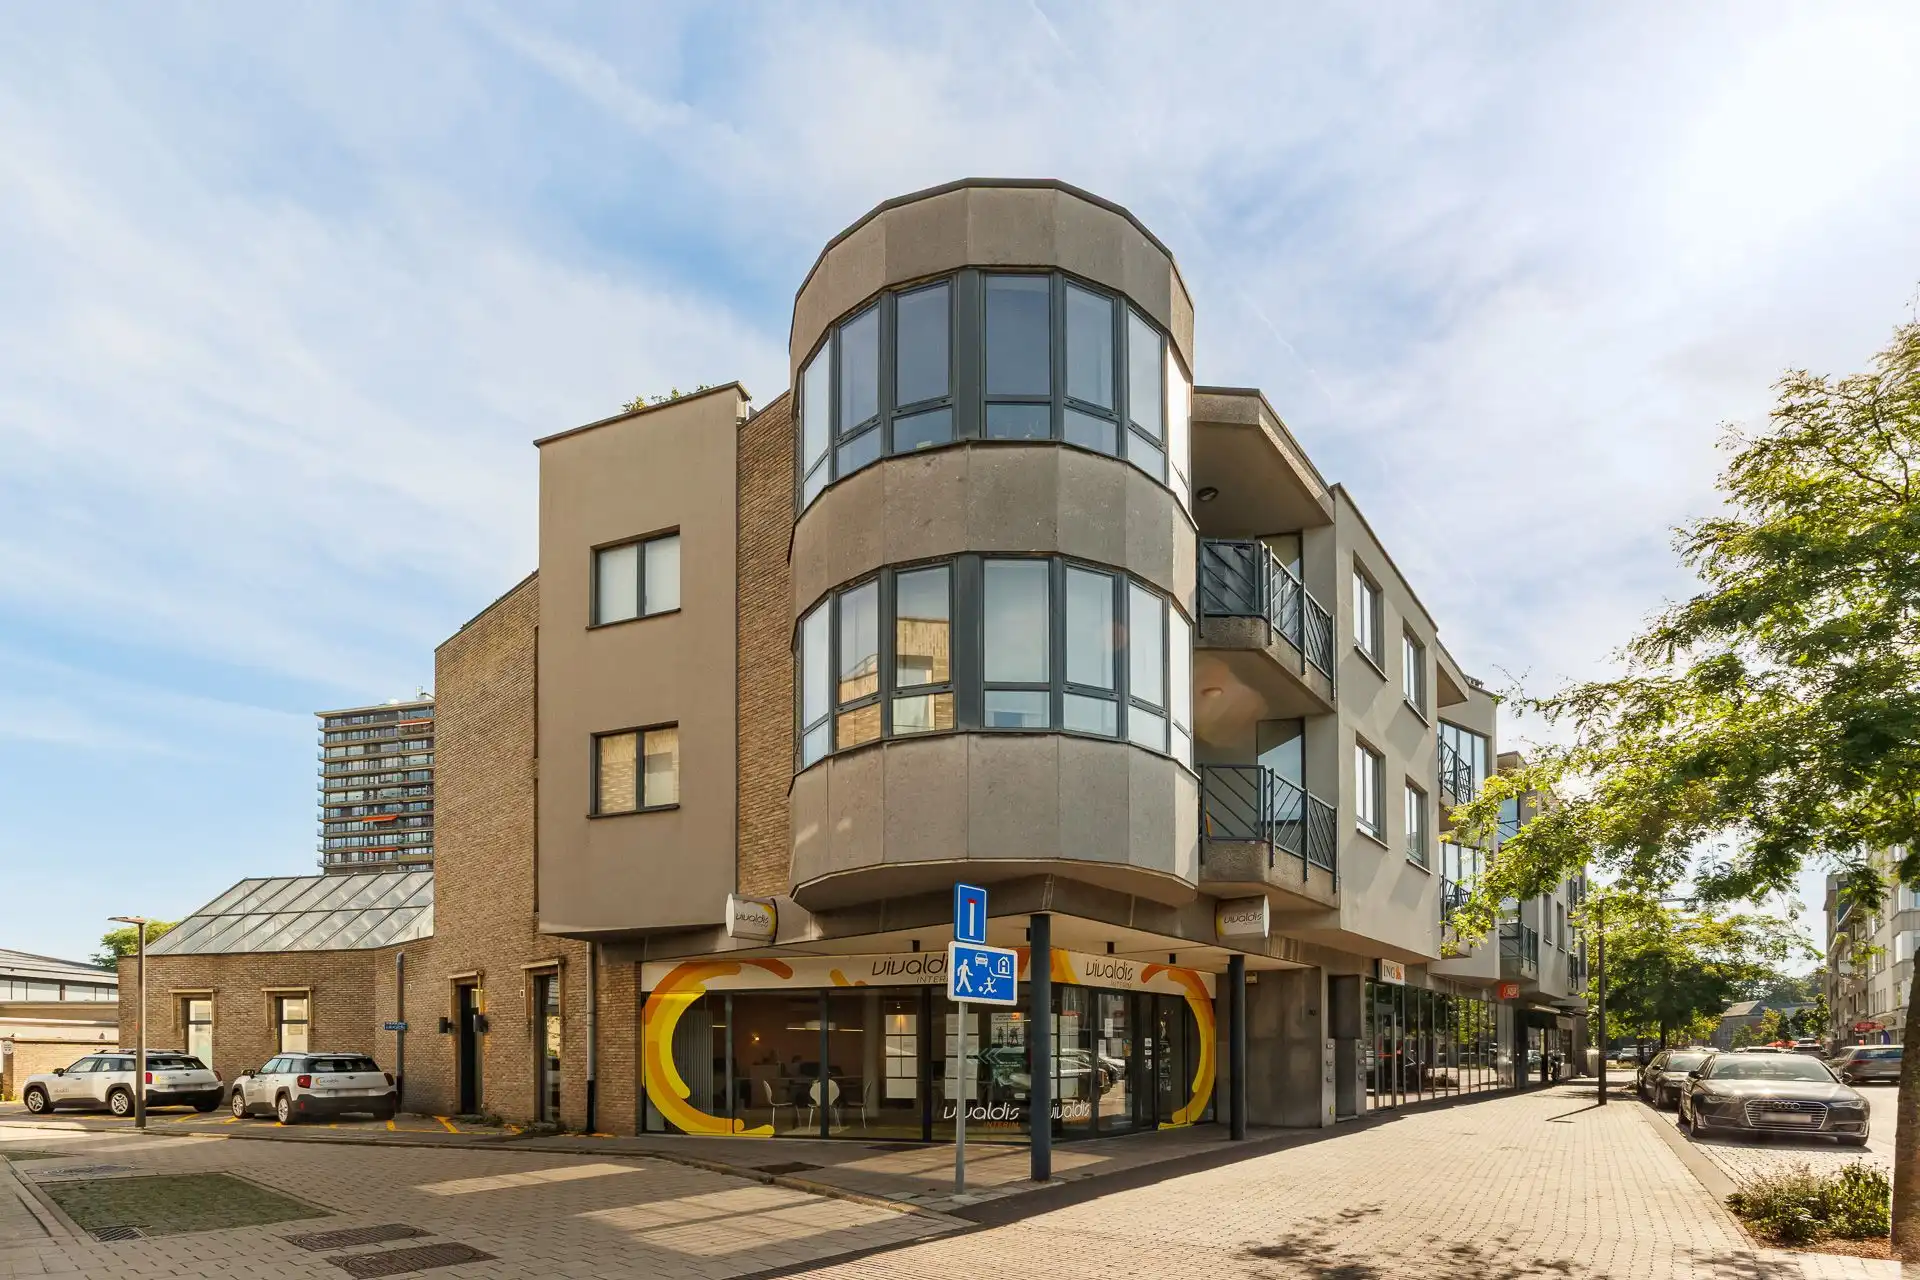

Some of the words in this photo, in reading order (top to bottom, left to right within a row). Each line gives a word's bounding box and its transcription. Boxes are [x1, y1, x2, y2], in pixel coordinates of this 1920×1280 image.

[872, 952, 948, 976] vivaldi
[1085, 959, 1133, 981] vivaldis
[1383, 964, 1396, 979] ING
[916, 975, 948, 983] INTER
